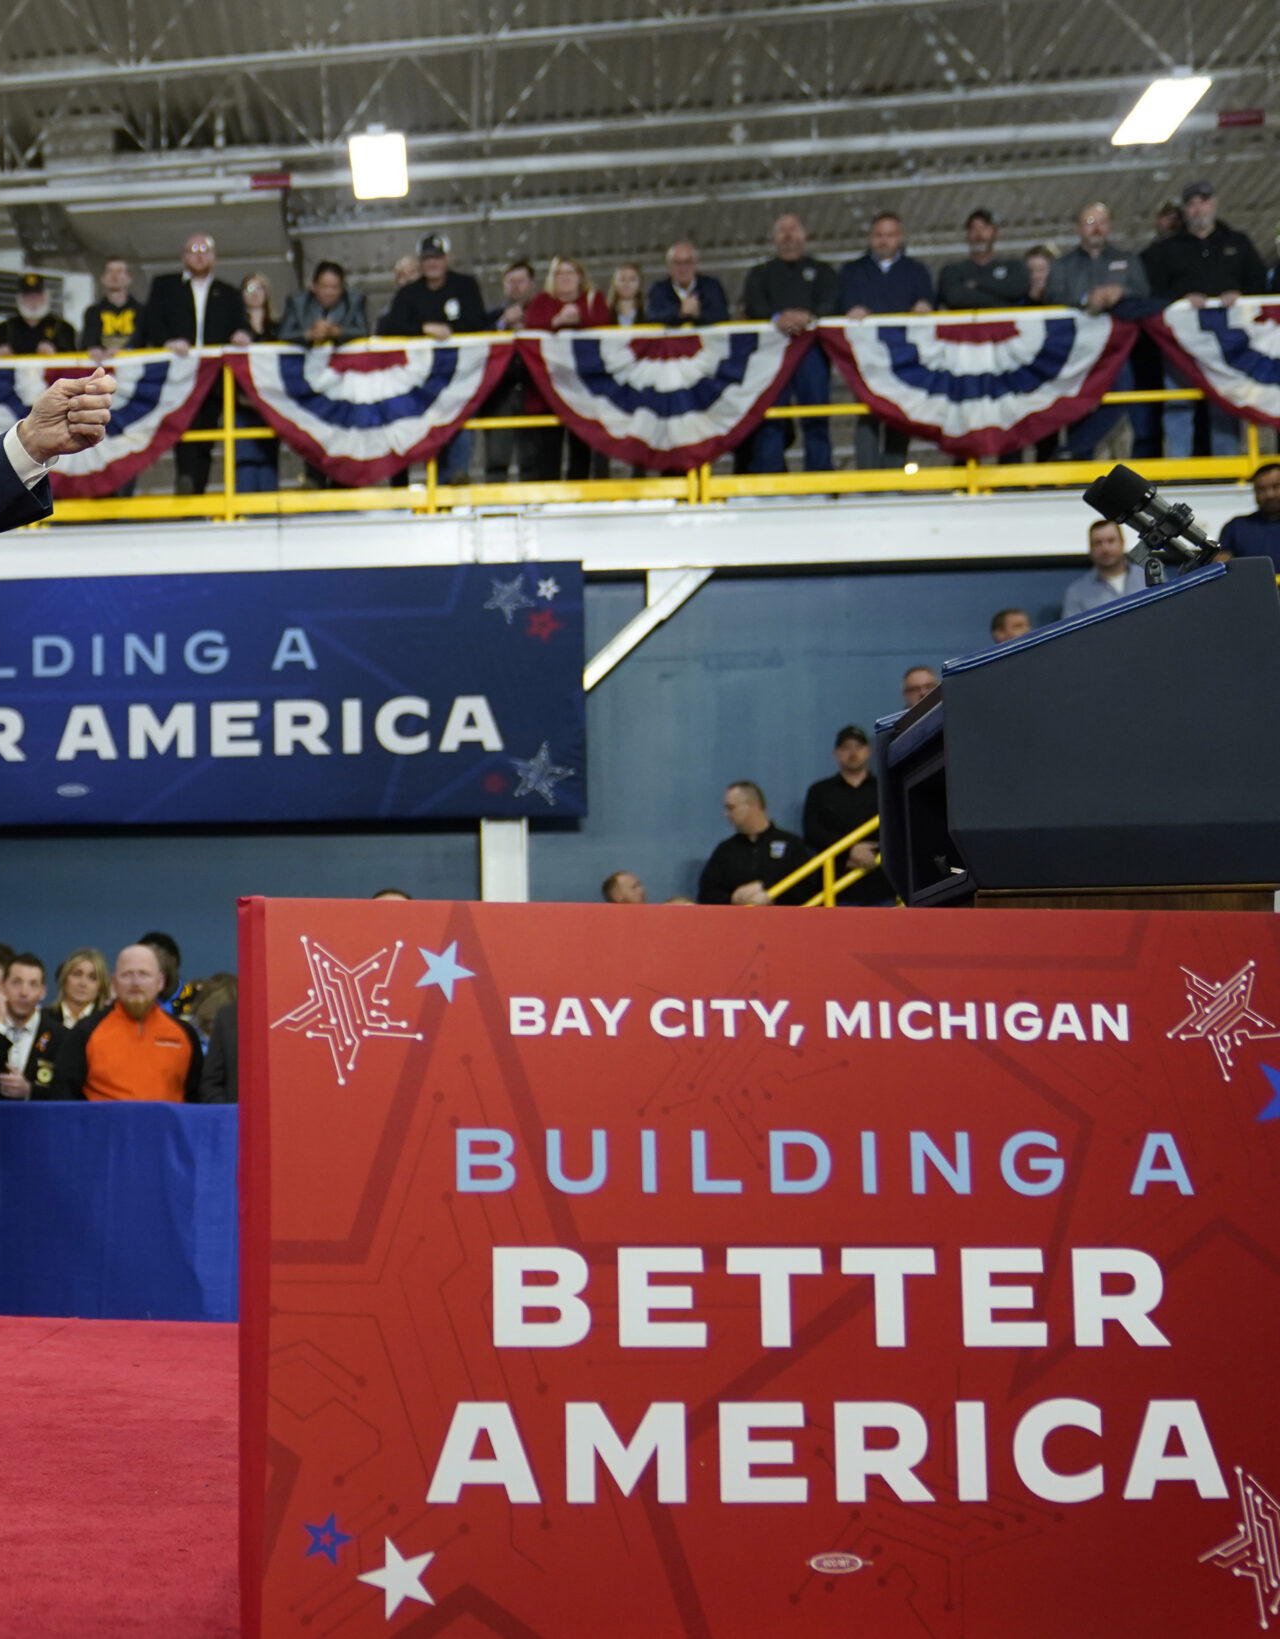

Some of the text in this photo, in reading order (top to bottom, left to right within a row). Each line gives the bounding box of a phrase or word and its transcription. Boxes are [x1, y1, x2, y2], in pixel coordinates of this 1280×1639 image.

[101, 309, 135, 335] M
[271, 627, 317, 671] A
[56, 696, 504, 761] AMERICA
[509, 996, 1129, 1047] BAY CITY, MICHIGAN
[455, 1127, 1194, 1196] BUILDING A
[492, 1246, 1171, 1348] BETTER
[426, 1397, 1229, 1504] AMERICA
